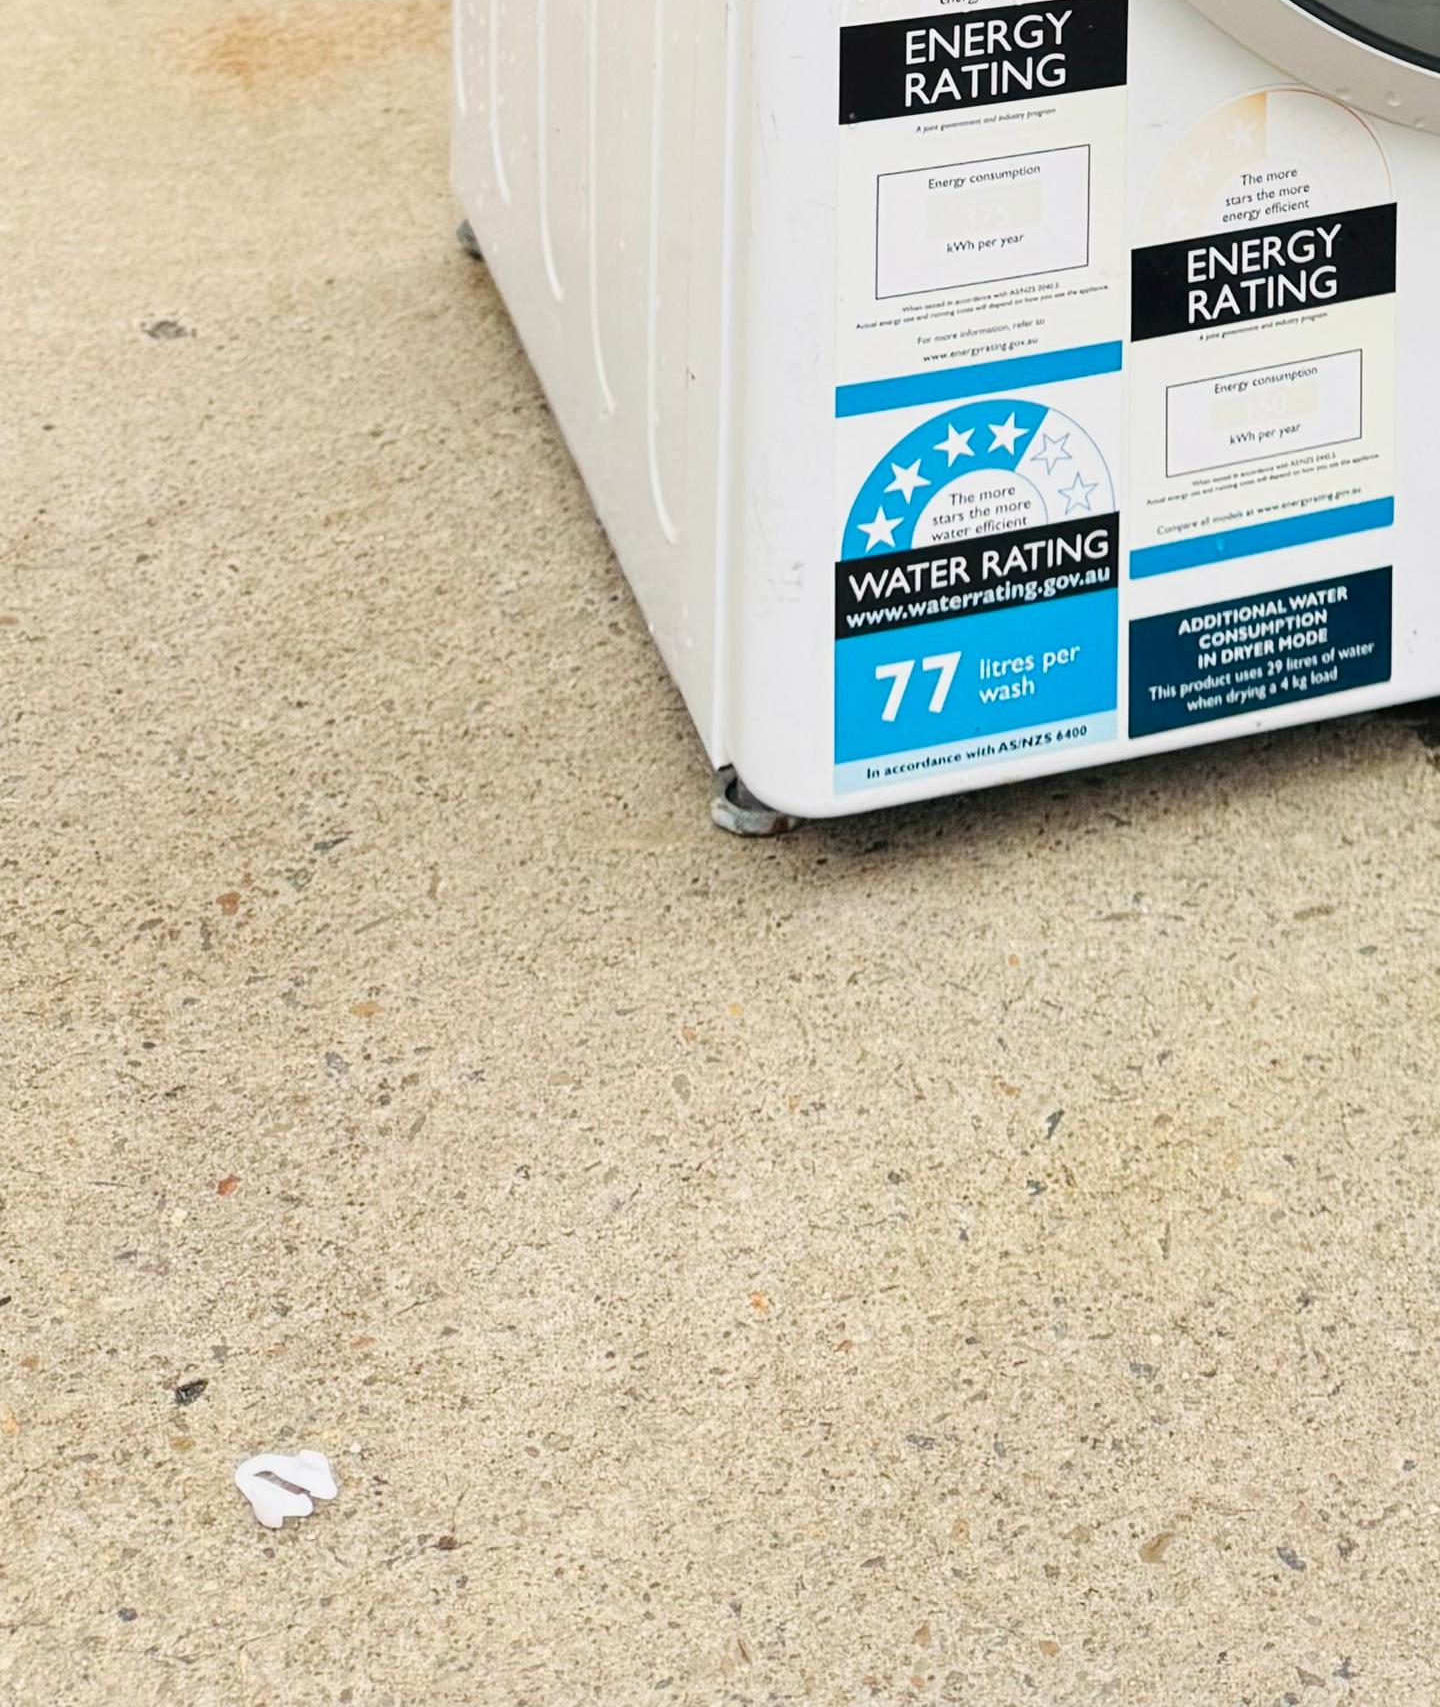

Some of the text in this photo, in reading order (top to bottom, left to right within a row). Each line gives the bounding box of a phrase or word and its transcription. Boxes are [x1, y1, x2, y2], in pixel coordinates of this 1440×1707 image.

[906, 10, 1072, 65] ENERGY
[905, 53, 1066, 107] RATING
[928, 165, 1041, 189] Energy consumption
[1225, 184, 1310, 206] stars the more
[1241, 169, 1297, 186] The more
[1222, 200, 1309, 222] energy efficient
[947, 234, 1024, 253] kWh per year
[1188, 224, 1342, 283] ENERGY
[1188, 266, 1337, 324] RATING
[917, 336, 931, 344] For
[1013, 319, 1032, 329] refer
[1215, 367, 1318, 394] Energy consumption
[1229, 424, 1301, 445] kWh per year
[932, 500, 1031, 526] stars the more
[950, 487, 1015, 506] The more
[931, 517, 1027, 541] water efficient
[849, 529, 1109, 603] WATER RATING
[846, 567, 1110, 628] www.waterrating.gov.au
[1178, 586, 1347, 636] ADDITIONAL WATER
[1199, 609, 1328, 649] CONSUMPTION
[980, 646, 1081, 679] litres per
[1198, 628, 1328, 669] IN DRYER MODE
[875, 650, 962, 722] 77
[979, 675, 1035, 704] wash
[1149, 643, 1374, 700] This product uses 29 litres of water
[1187, 666, 1338, 712] when drying a 4 kg load
[867, 725, 1088, 779] In accordance with AS/NZS 6400
